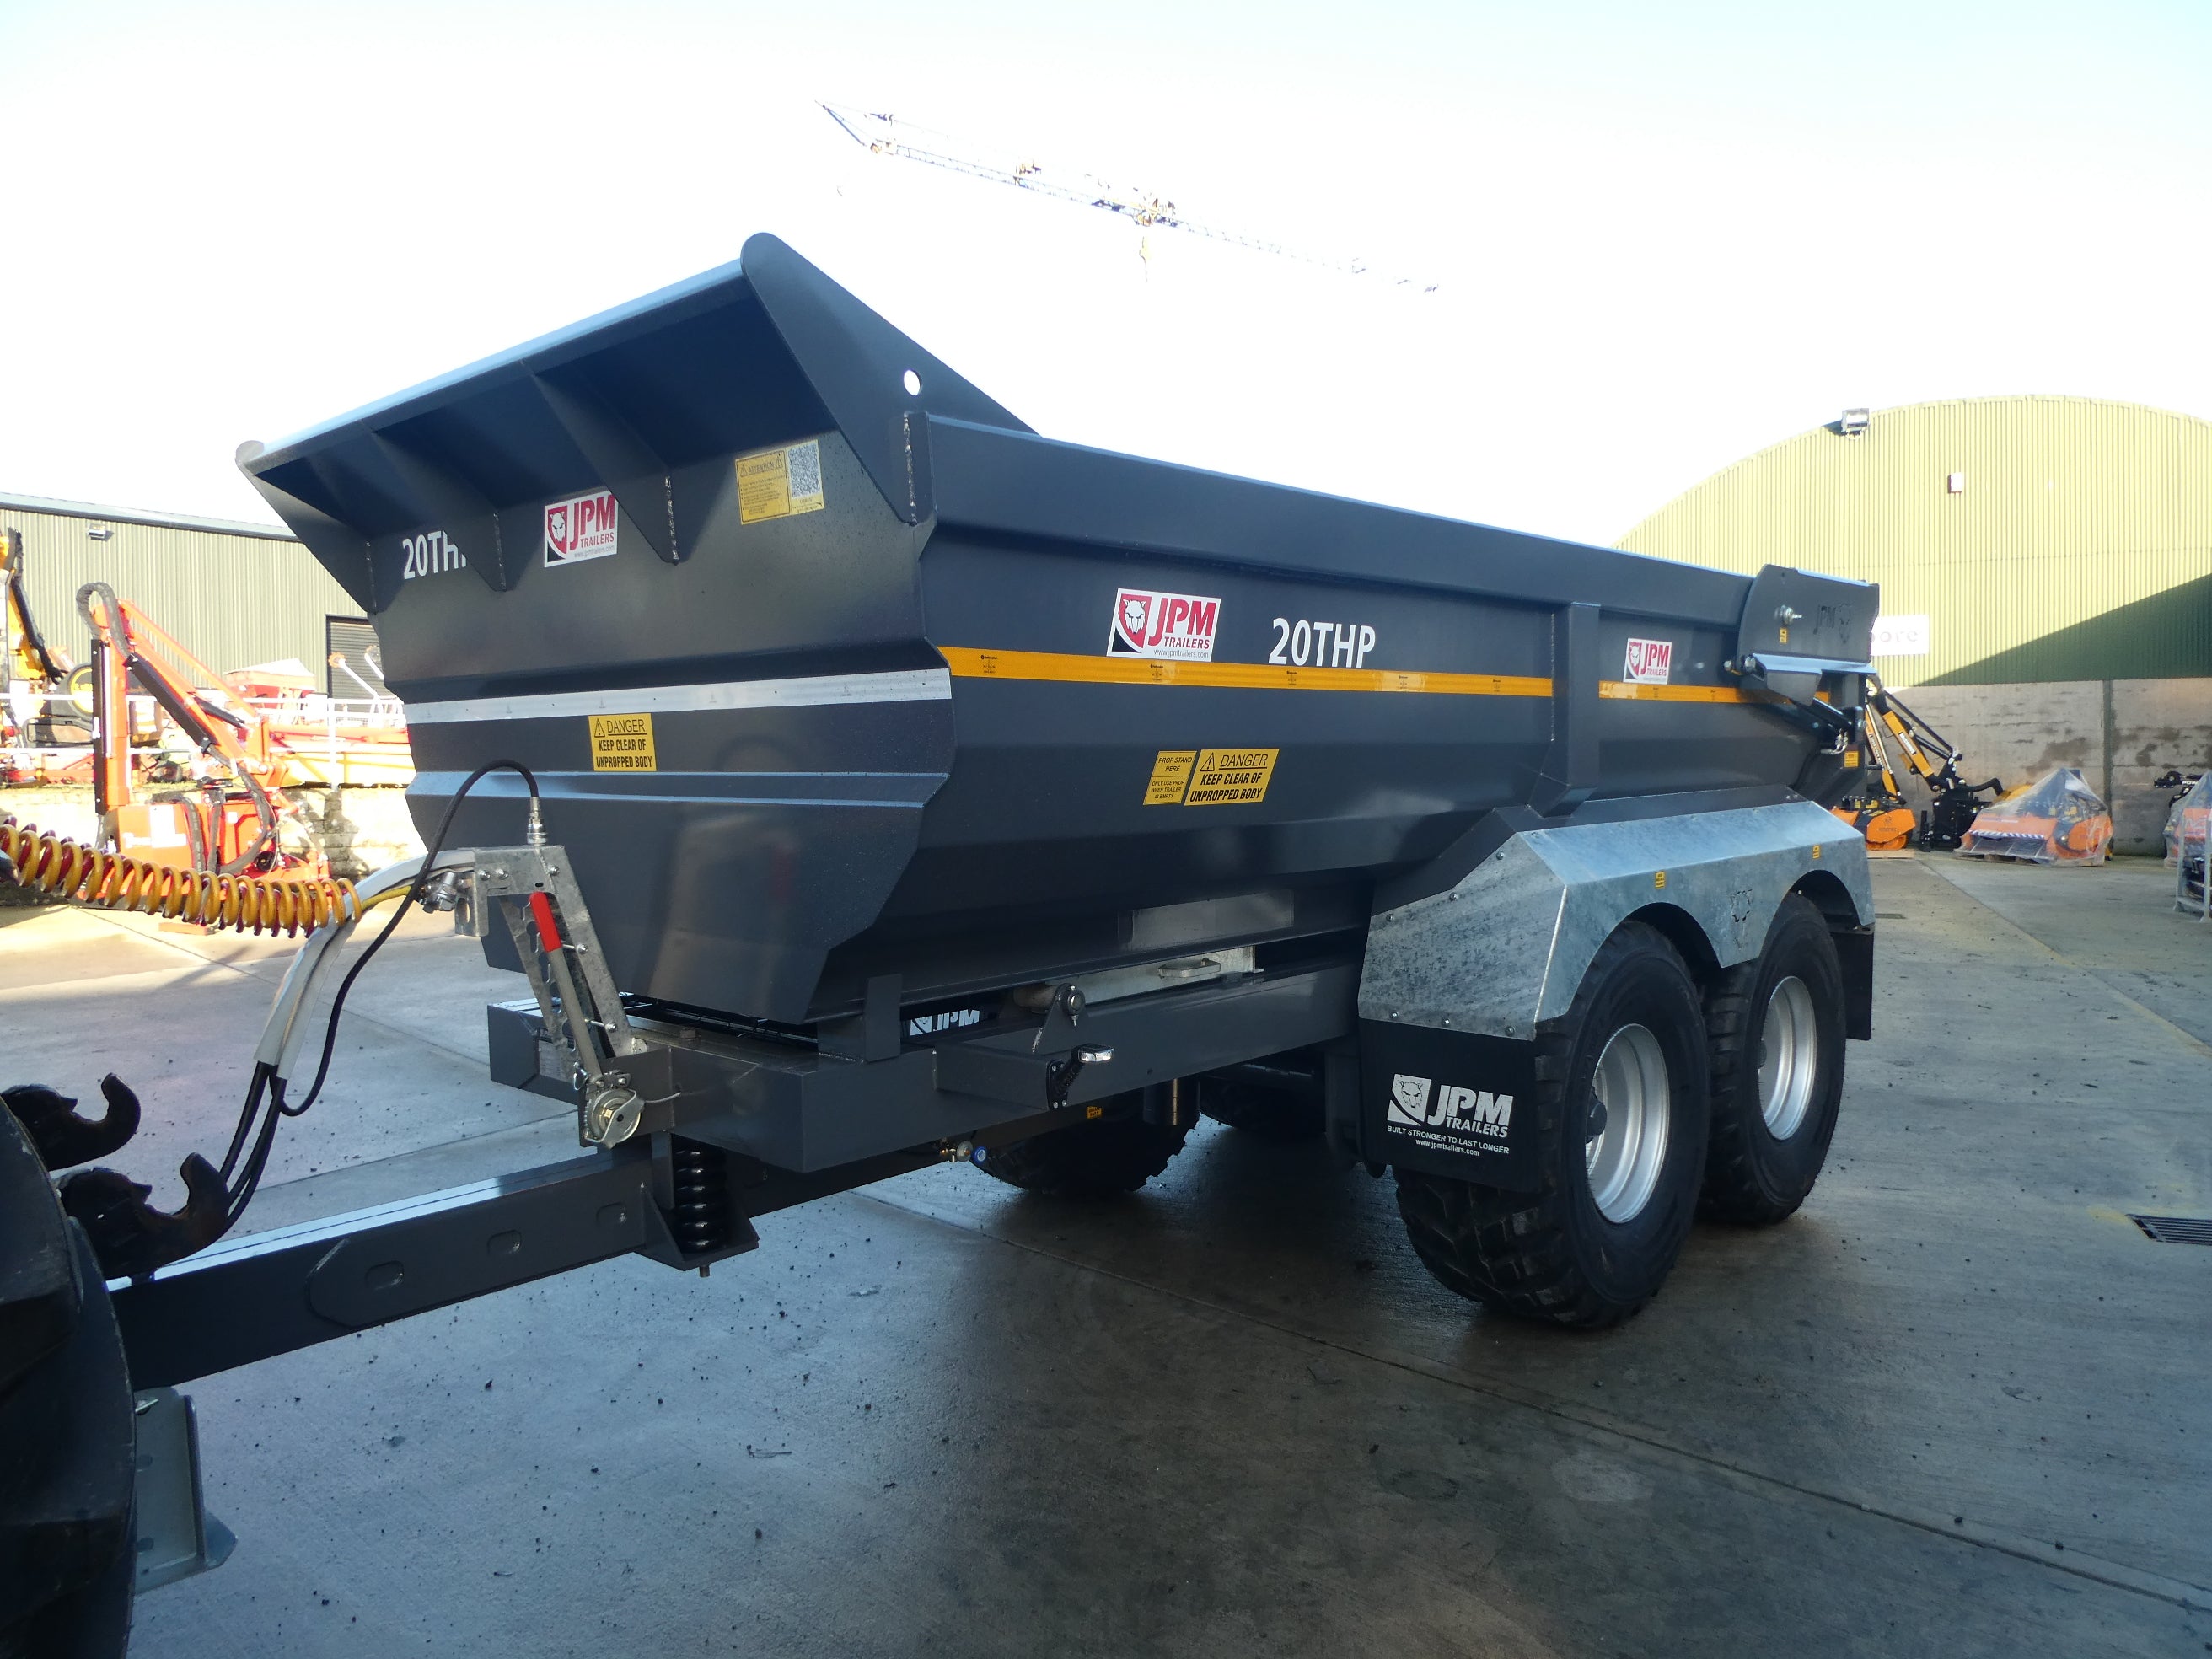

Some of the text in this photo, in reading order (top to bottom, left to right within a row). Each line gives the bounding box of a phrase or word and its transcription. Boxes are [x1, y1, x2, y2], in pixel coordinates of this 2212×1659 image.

[570, 495, 615, 551] JPM
[580, 532, 615, 548] TRAILERS
[402, 530, 466, 580] 20TH
[1147, 597, 1217, 646] JPM
[1164, 636, 1210, 649] TRAILERS
[1268, 617, 1376, 668] 20THP
[1153, 648, 1209, 658] www.jpmtrailers.com
[1640, 643, 1670, 675] JPM
[607, 719, 646, 733] DANGER
[599, 738, 647, 751] KEEP CLEAR OF
[596, 755, 652, 768] UNPROPPED BODY
[1220, 754, 1269, 767] DANGER
[1200, 772, 1263, 786] KEEP CLEAR OF
[1189, 787, 1263, 802] UNPROPPED BODY
[1427, 1084, 1514, 1126] JPM
[1446, 1116, 1509, 1138] TRAILERS
[1387, 1125, 1510, 1154] BUILT STRONGER TO LAST LONGER
[1415, 1138, 1479, 1157] www.jpmtrailers.com
